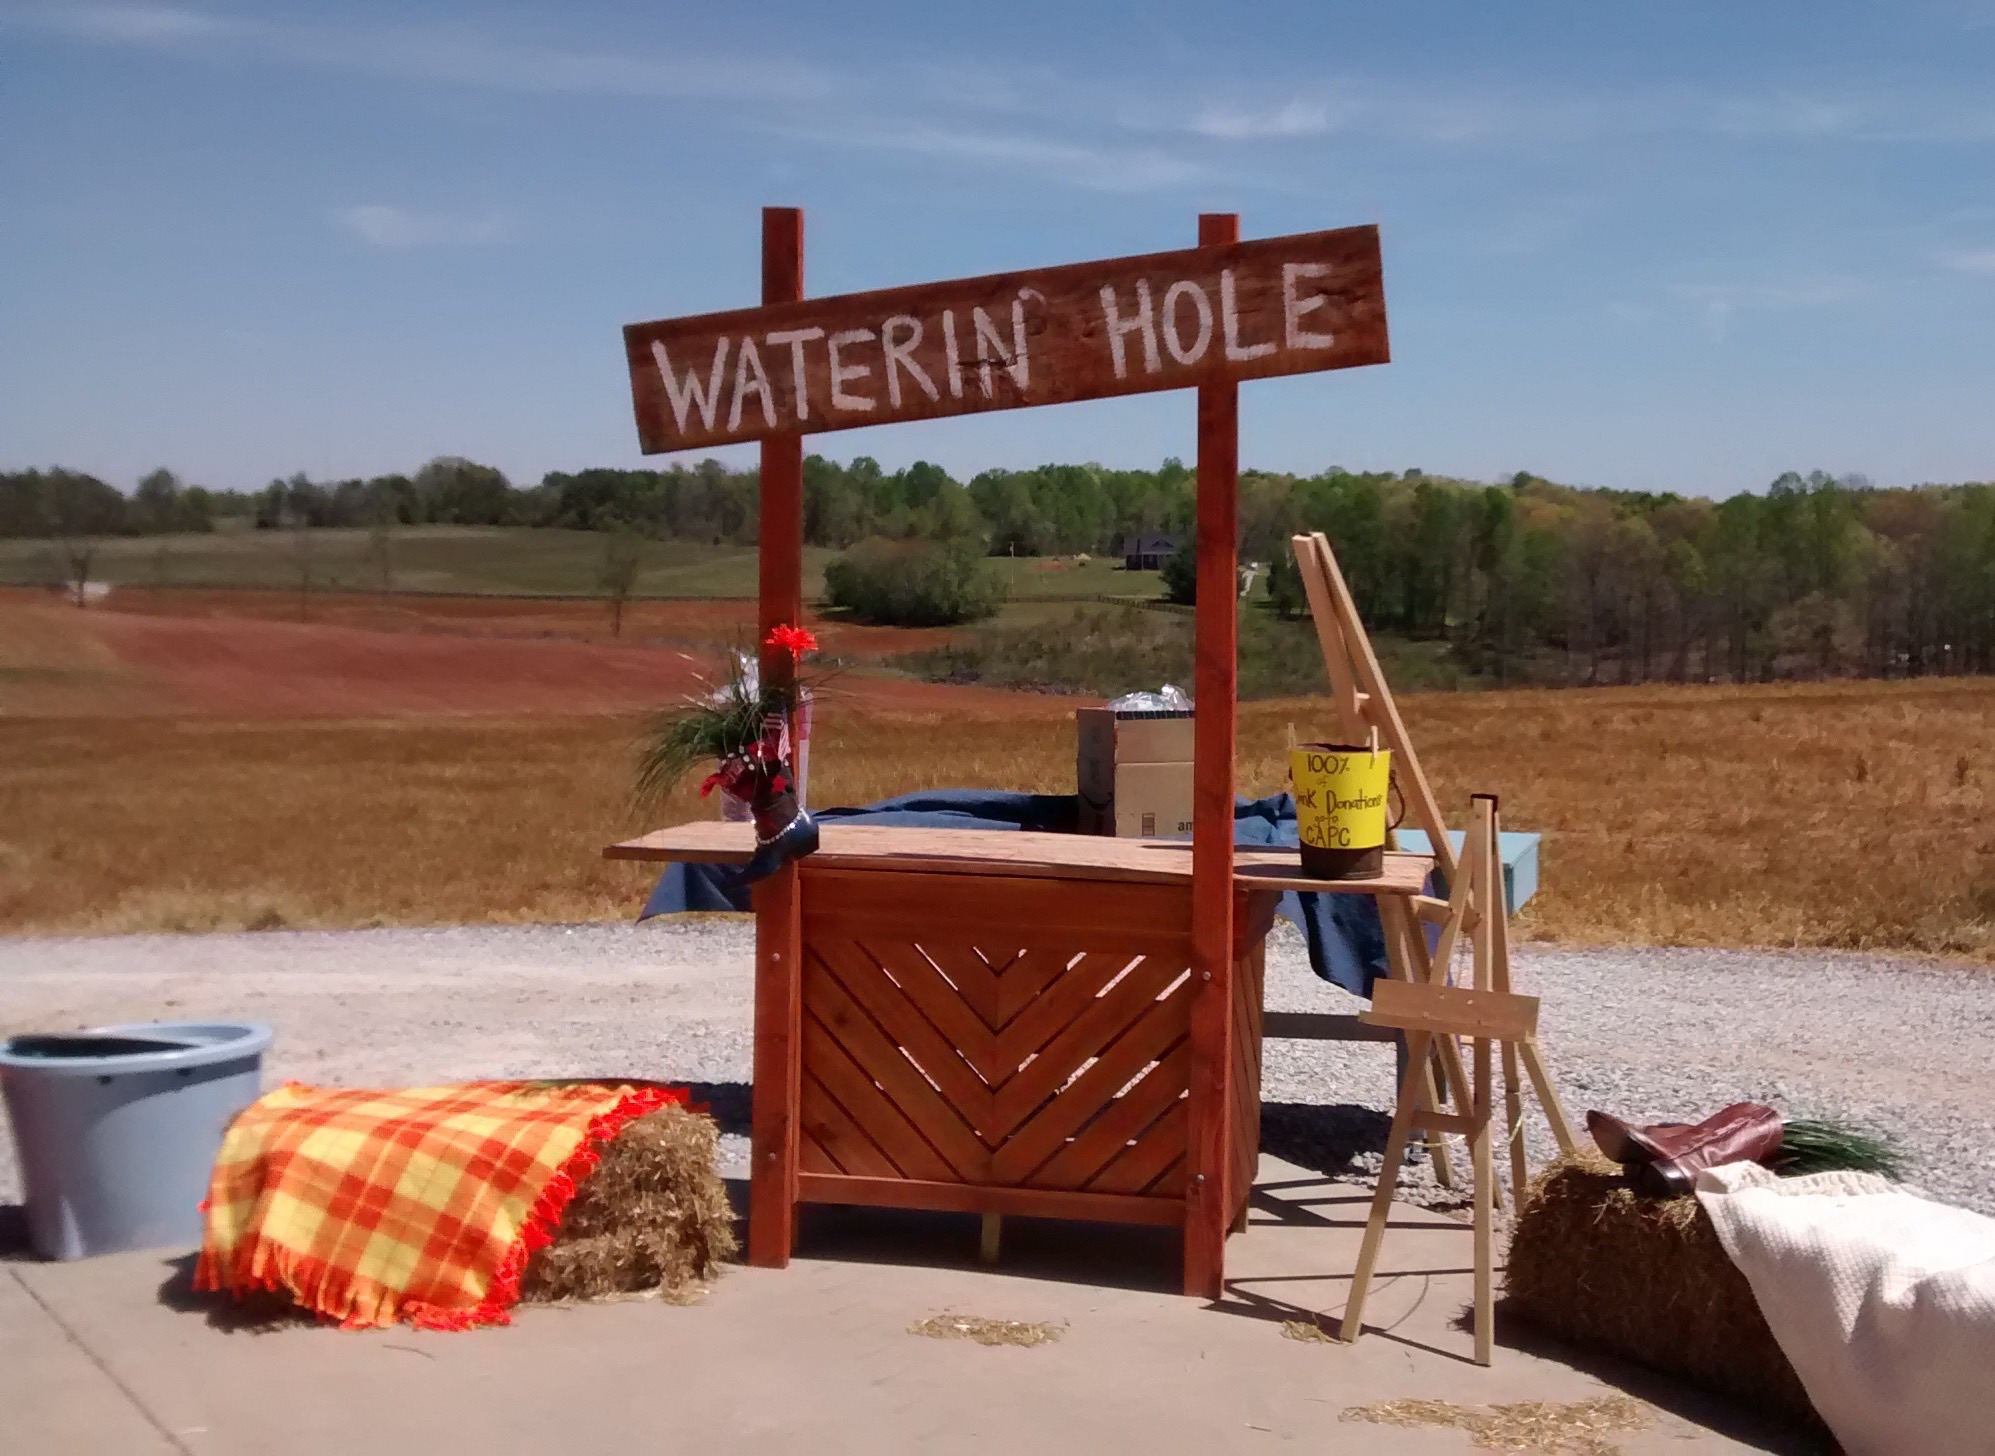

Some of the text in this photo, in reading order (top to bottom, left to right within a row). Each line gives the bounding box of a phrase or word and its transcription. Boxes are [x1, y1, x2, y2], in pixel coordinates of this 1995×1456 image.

[1099, 261, 1335, 380] HOLE
[1307, 753, 1350, 775] 100%
[1317, 776, 1328, 788] of
[1306, 822, 1351, 847] CAPC
